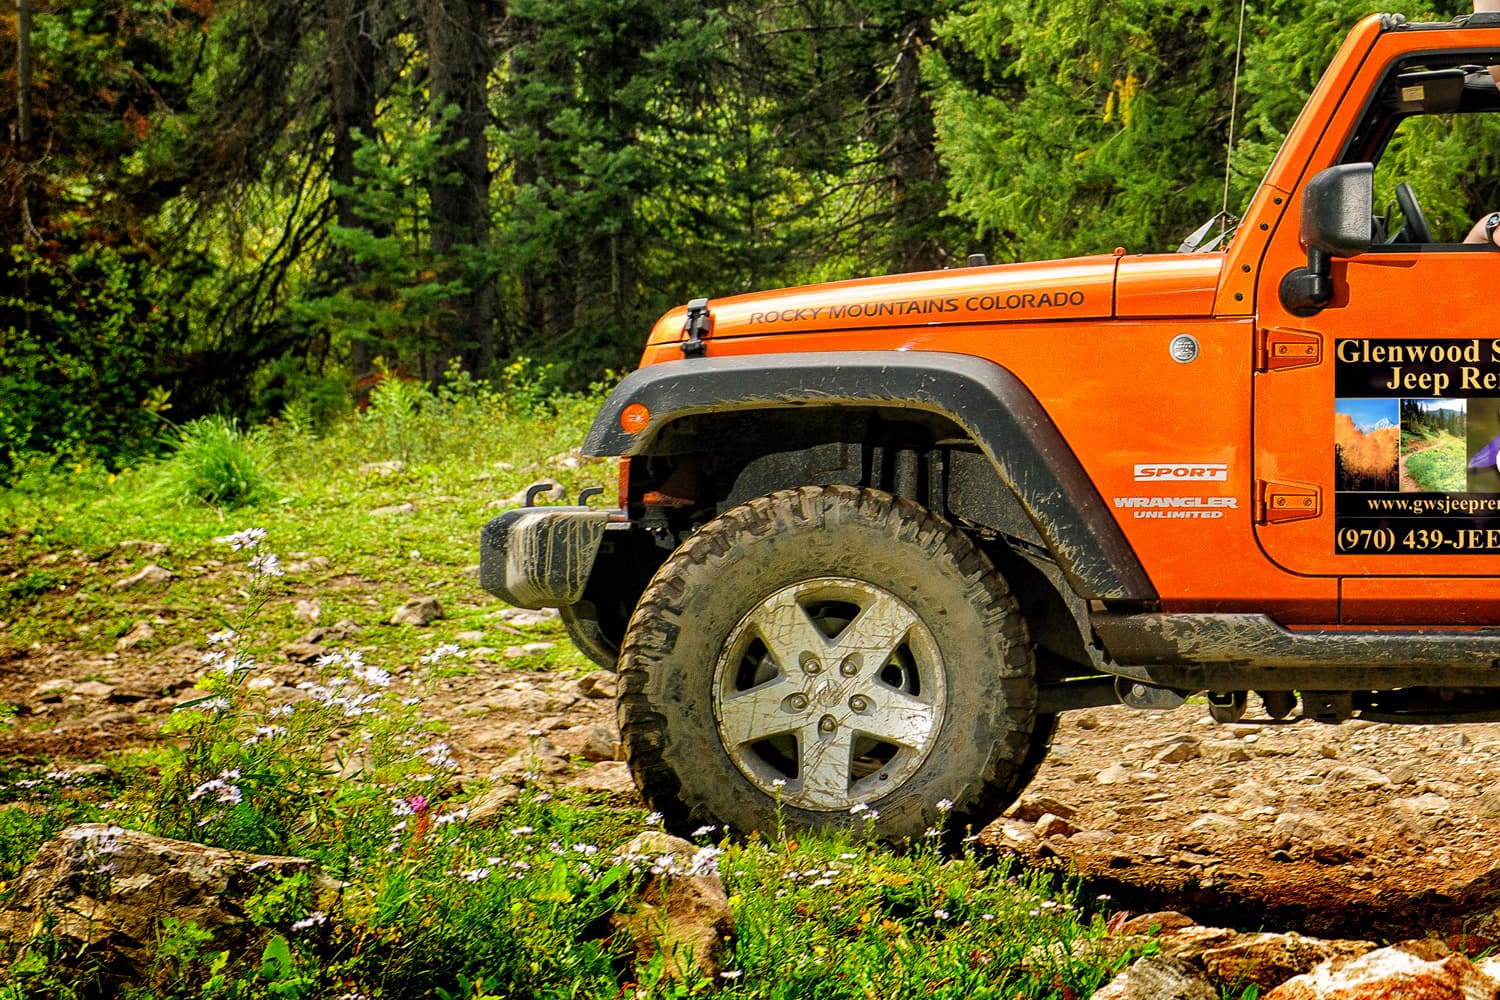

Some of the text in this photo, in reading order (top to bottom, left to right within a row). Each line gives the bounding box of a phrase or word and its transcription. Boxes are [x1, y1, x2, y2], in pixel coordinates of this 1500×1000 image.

[749, 291, 1085, 325] ROCKY MOUNTAINS COLORADO
[1336, 339, 1480, 363] Glenwood
[1386, 366, 1450, 395] Jeep
[1137, 467, 1226, 478] SPORT
[1113, 497, 1239, 509] WRANGLER
[1133, 511, 1224, 519] UNLIMITED
[1337, 527, 1396, 552] (970)
